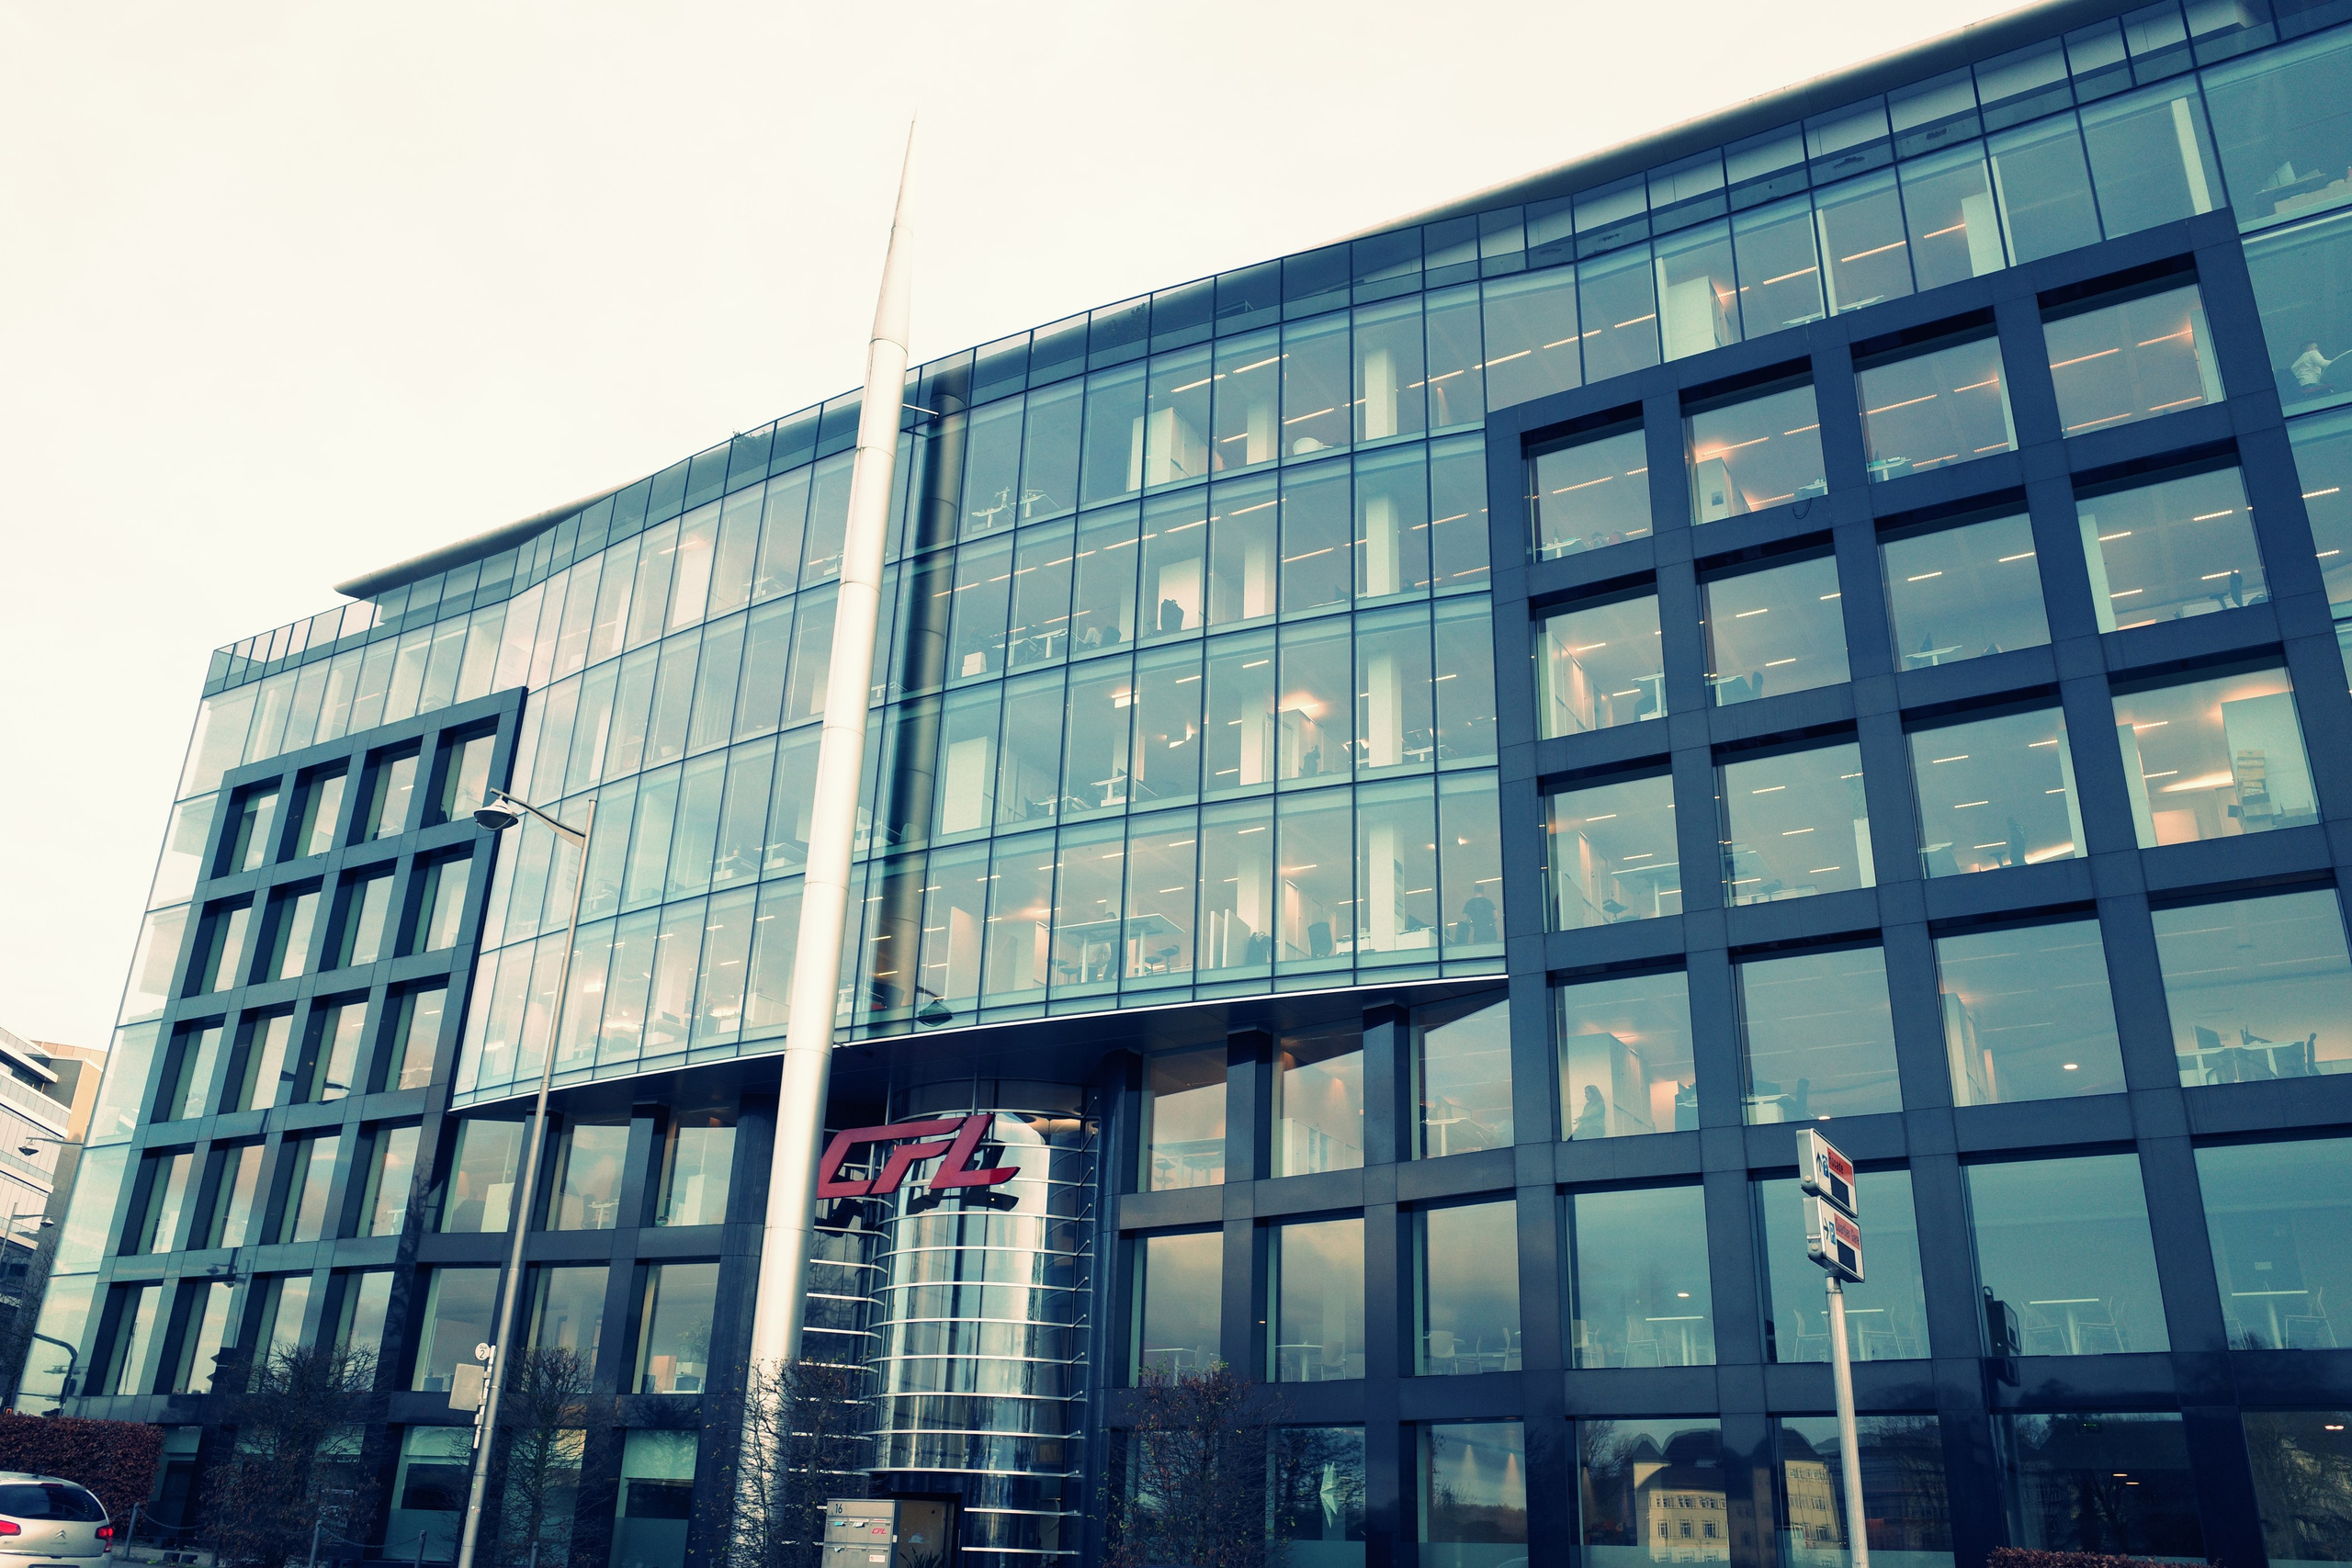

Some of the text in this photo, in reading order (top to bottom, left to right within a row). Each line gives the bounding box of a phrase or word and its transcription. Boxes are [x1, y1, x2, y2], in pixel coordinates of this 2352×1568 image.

[817, 1113, 1021, 1199] CFL
[1828, 1152, 1844, 1174] Rocade
[1835, 1217, 1860, 1246] Quartier Gare
[480, 1349, 485, 1359] 2
[835, 1503, 843, 1514] 16
